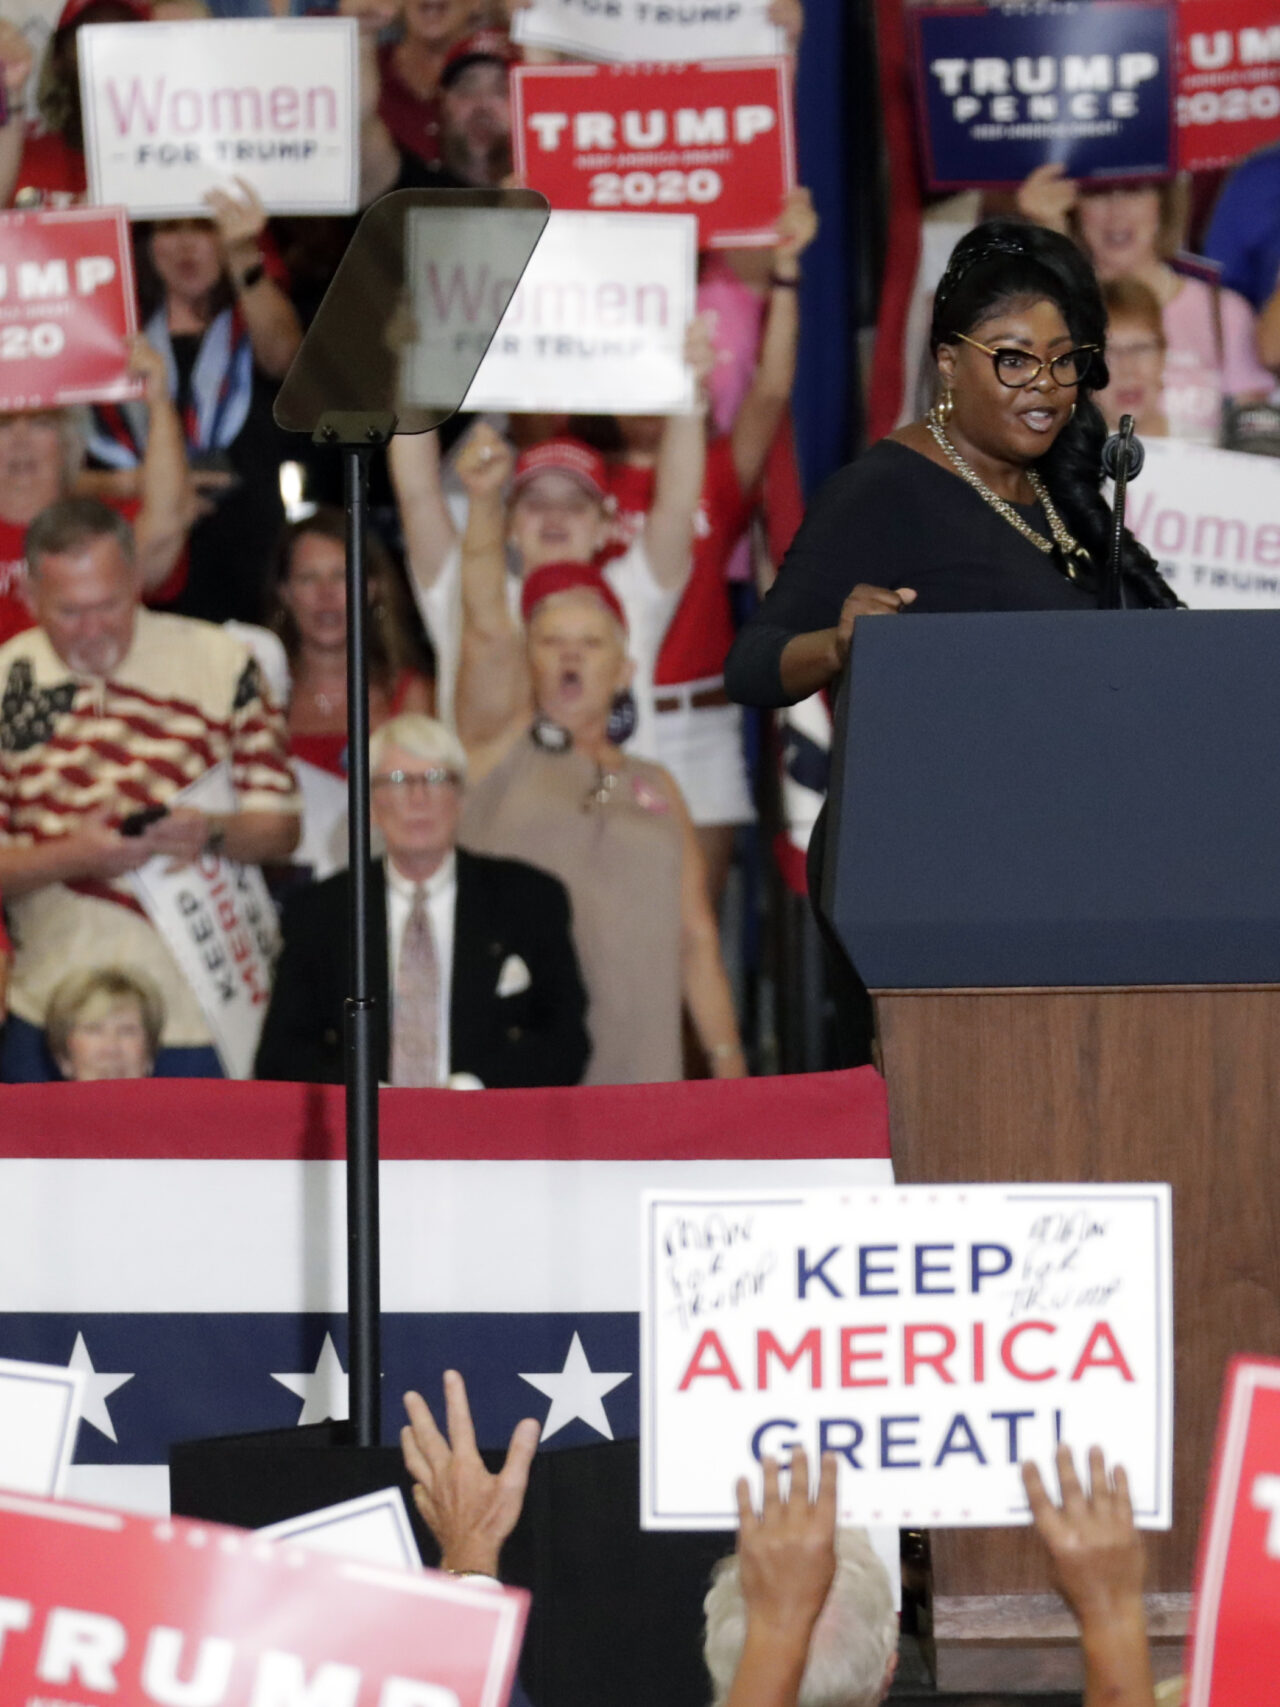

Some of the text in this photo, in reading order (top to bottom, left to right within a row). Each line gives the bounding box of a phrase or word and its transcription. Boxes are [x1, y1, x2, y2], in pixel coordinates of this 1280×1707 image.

[931, 53, 1158, 96] TRUMP
[106, 77, 339, 138] Women
[528, 105, 776, 150] TRUMP
[953, 92, 1138, 123] PENCE
[136, 139, 318, 166] FOR TRUMP
[589, 169, 721, 206] 2020
[0, 256, 116, 299] MP
[426, 260, 669, 327] Women
[797, 1242, 1013, 1300] KEEP
[678, 1320, 1135, 1392] AMERICA
[751, 1408, 1062, 1471] GREAT!
